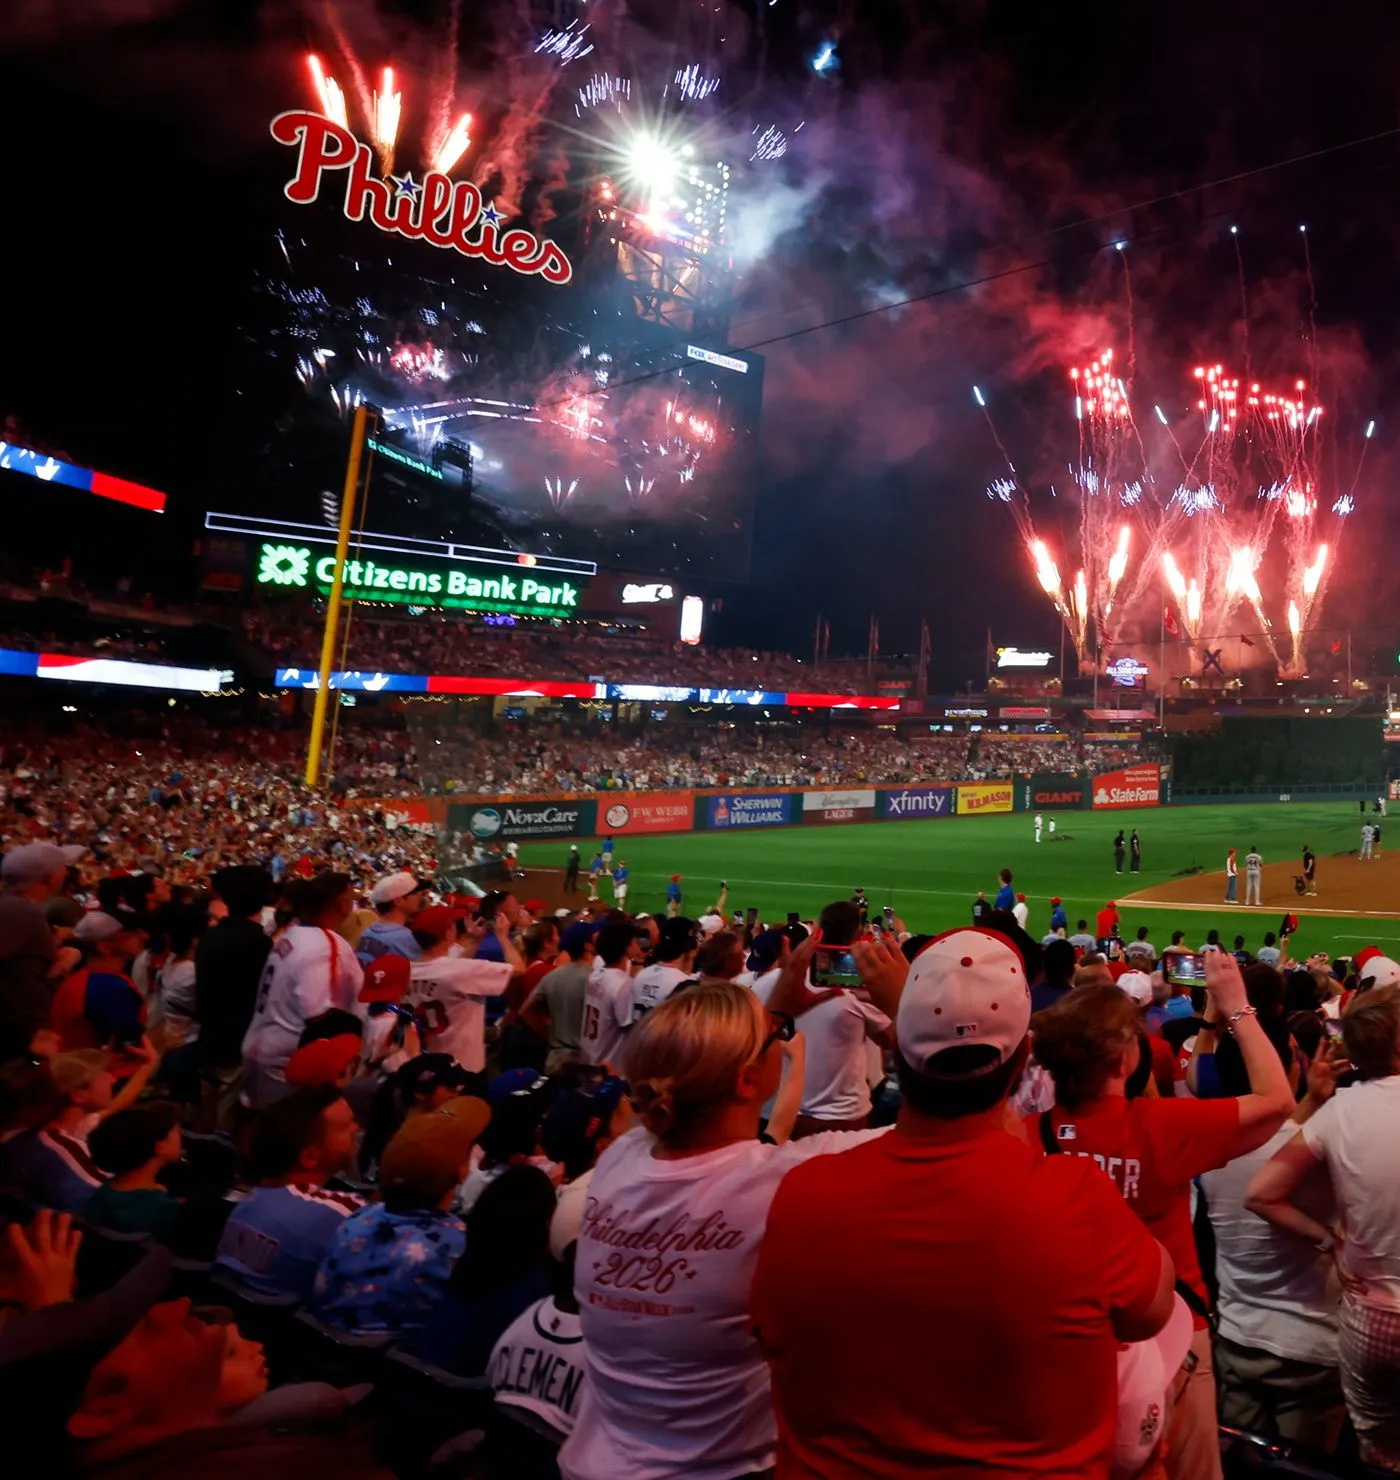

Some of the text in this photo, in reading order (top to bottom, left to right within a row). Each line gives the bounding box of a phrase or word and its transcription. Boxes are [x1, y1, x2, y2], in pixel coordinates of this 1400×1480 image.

[270, 110, 572, 284] Phillies
[406, 456, 426, 473] Bank
[426, 465, 443, 480] Park
[316, 556, 578, 607] Citizens Bank Park
[732, 797, 783, 811] SHERWIN
[889, 791, 945, 814] xfinity
[1035, 791, 1082, 803] GIANT
[502, 807, 579, 825] NovaCare
[824, 809, 853, 819] LAGER
[585, 1196, 744, 1256] Philadelphia
[594, 1252, 688, 1294] 2026
[494, 1346, 585, 1414] CLEMEN
